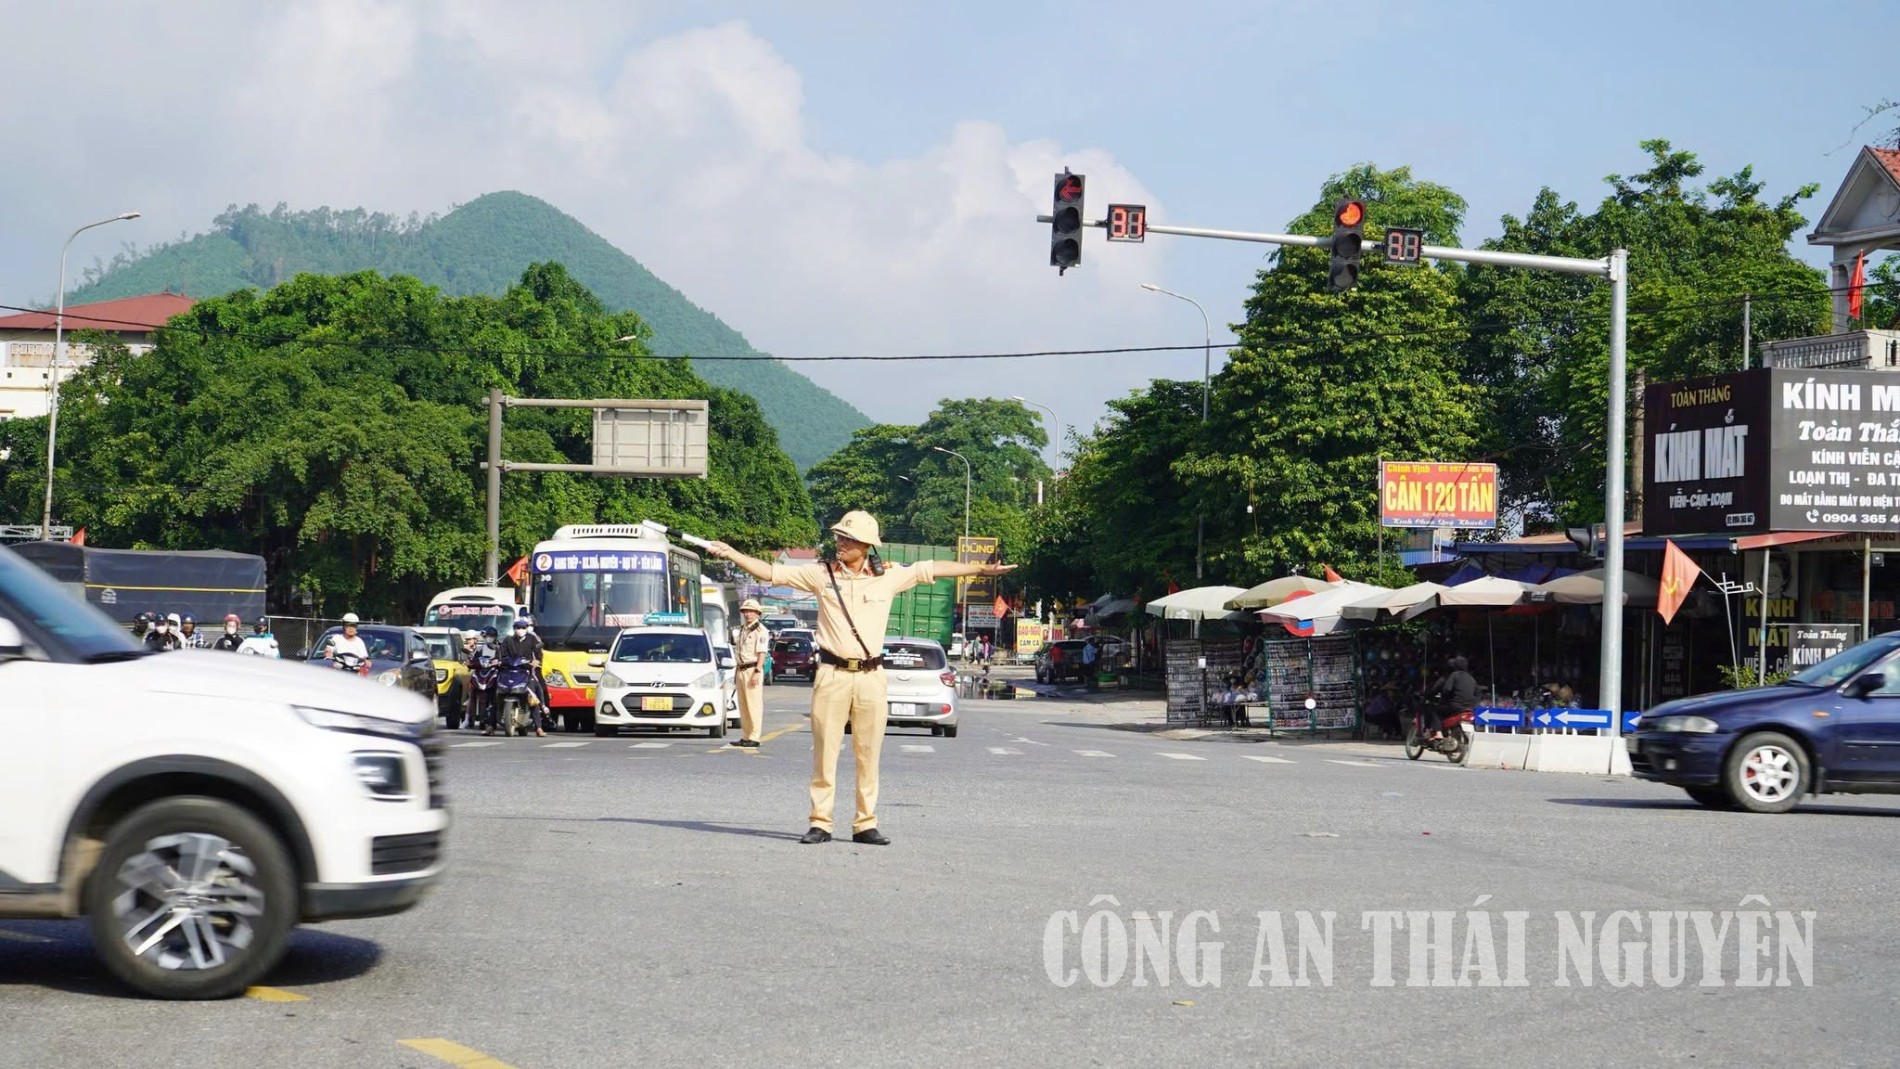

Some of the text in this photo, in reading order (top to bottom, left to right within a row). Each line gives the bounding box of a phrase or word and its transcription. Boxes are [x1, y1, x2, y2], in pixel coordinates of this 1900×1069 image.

[1670, 378, 1731, 408] TOÀN THẮNG
[1783, 377, 1860, 411] KÍNH
[1799, 419, 1852, 442] Toàn
[1655, 408, 1749, 483] KÍNH MẮT
[1812, 448, 1845, 465] KÍNH
[1849, 447, 1880, 465] VIỄN
[1789, 470, 1825, 487] LOẠN
[1828, 472, 1850, 488] THỊ
[1867, 472, 1886, 486] ĐA
[1385, 473, 1493, 513] CÂN 120 TẤN
[1780, 494, 1792, 506] ĐO
[1794, 491, 1812, 506] MẮT
[1814, 490, 1837, 507] BẰNG
[1839, 494, 1858, 507] MÁY
[1860, 495, 1871, 507] ĐO
[1873, 494, 1892, 510] ĐIỆN
[1823, 513, 1857, 524] 0904
[1861, 514, 1886, 524] 365
[961, 542, 995, 554] DŨNG
[1746, 598, 1795, 617] KNH
[1797, 628, 1847, 641] Toàn Thắng
[1792, 645, 1822, 665] KÍNH
